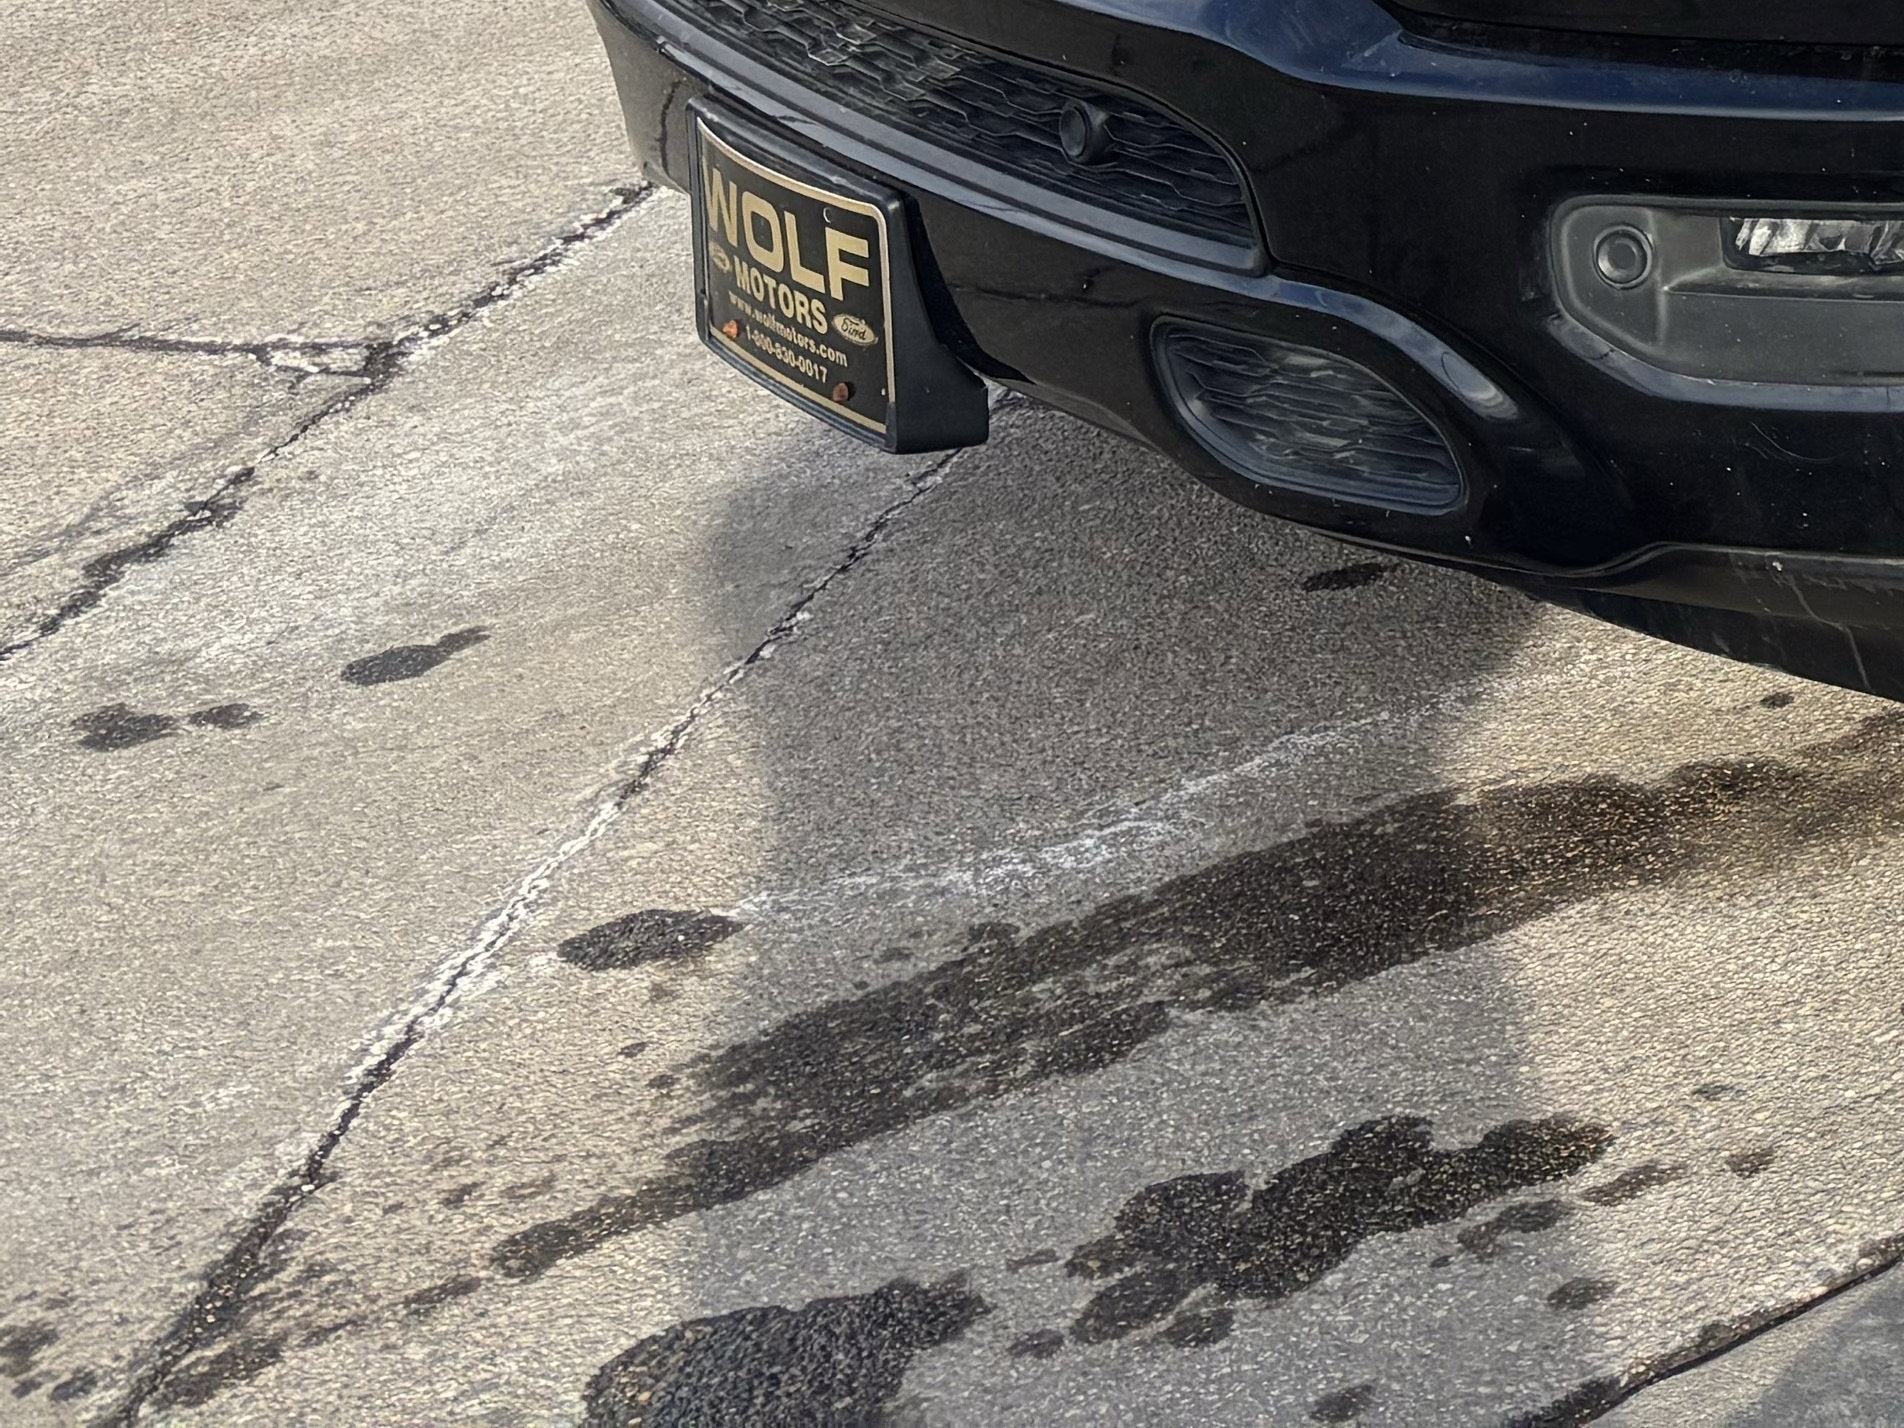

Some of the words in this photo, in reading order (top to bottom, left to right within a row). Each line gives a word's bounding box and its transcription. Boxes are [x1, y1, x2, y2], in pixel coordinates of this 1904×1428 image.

[703, 162, 870, 301] WOLF
[734, 255, 828, 335] MOTORS
[841, 317, 867, 342] Ford
